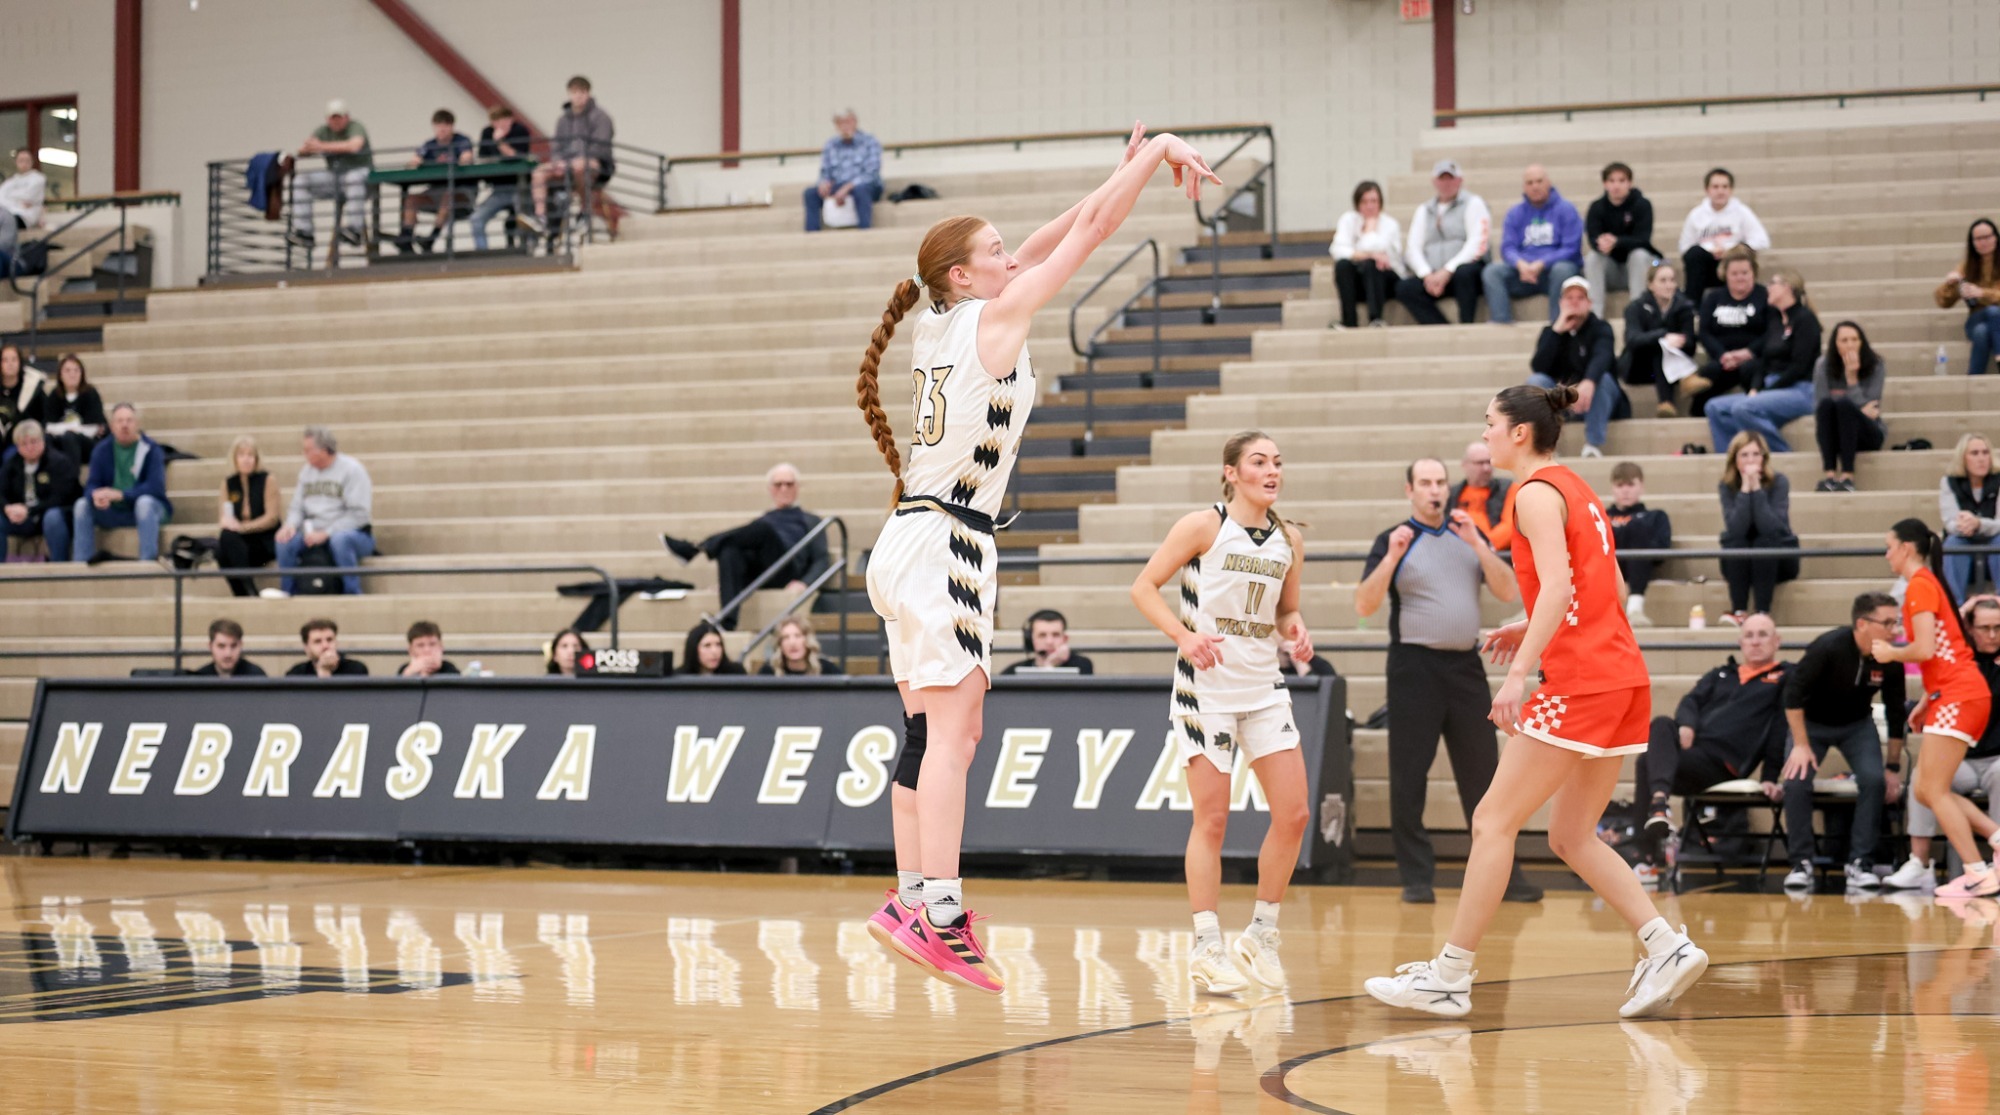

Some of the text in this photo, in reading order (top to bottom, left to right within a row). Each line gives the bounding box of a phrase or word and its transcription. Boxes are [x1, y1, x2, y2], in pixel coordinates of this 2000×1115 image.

[1245, 581, 1266, 615] 11
[595, 649, 640, 667] POSS
[40, 722, 597, 800] NEBRASKA
